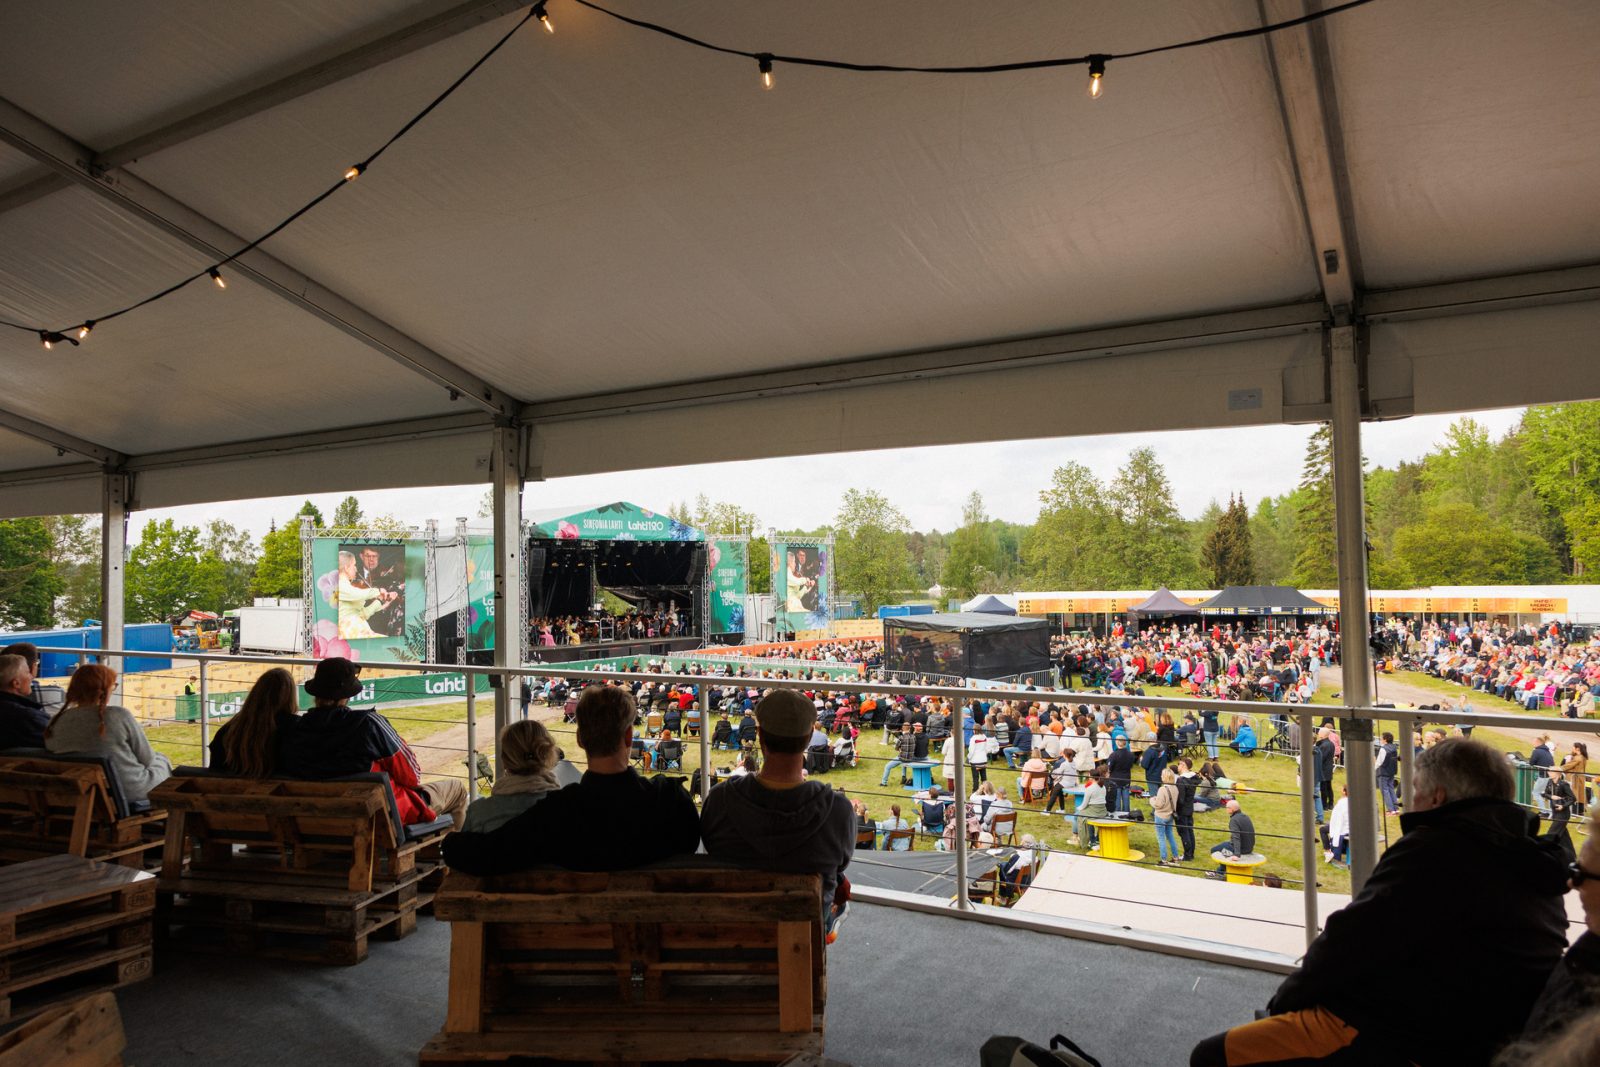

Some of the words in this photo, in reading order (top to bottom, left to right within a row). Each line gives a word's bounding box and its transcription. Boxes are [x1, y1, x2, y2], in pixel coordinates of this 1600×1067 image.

[583, 519, 608, 530] SINFONIA
[609, 519, 623, 529] LAHTI
[425, 675, 466, 694] Lahti
[209, 697, 245, 716] Lah
